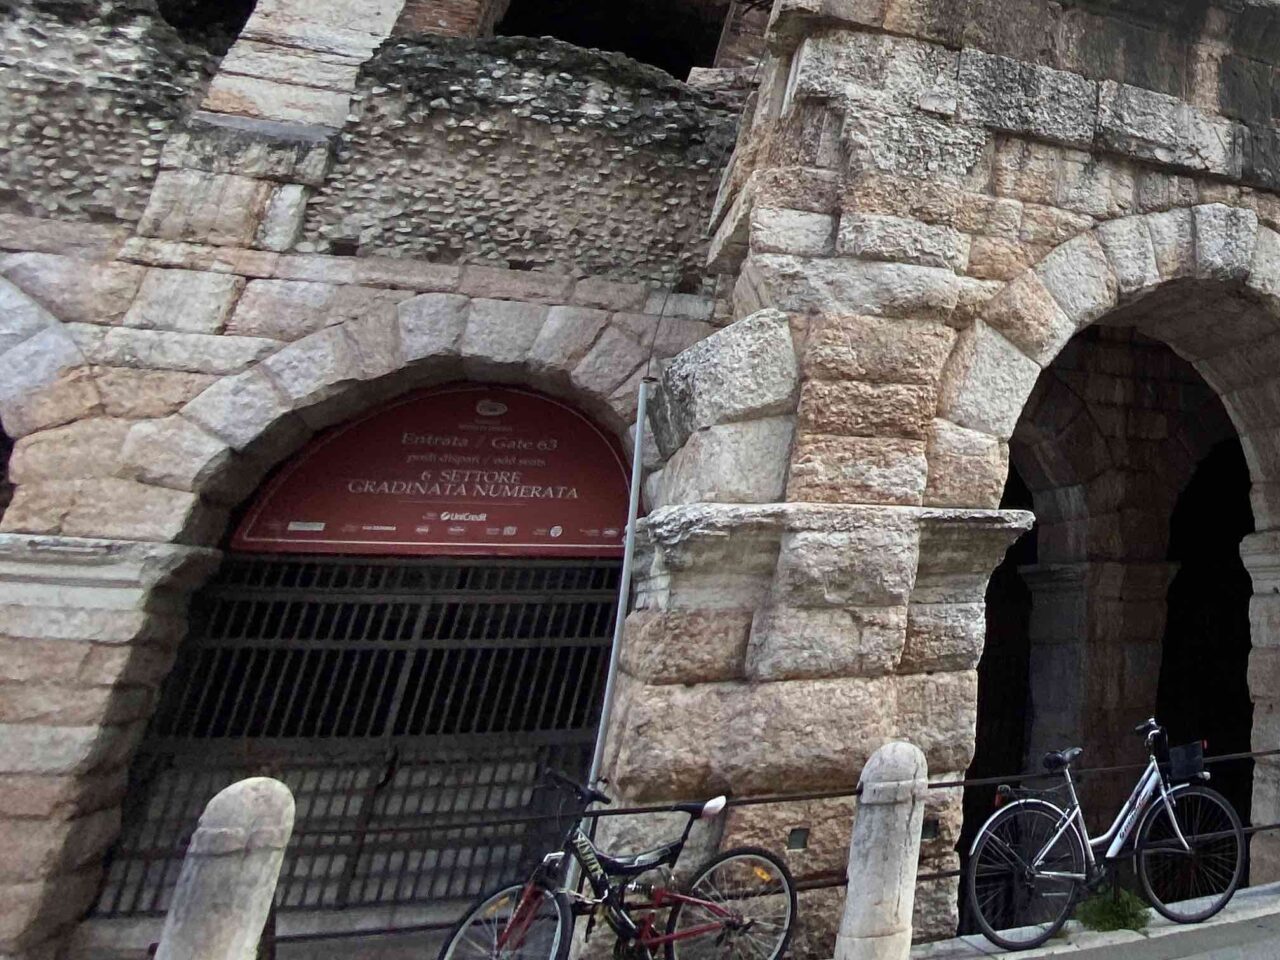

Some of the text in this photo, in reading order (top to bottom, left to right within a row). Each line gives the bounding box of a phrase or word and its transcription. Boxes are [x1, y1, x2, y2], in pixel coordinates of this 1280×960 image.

[401, 432, 468, 447] Entrata
[491, 437, 533, 450] Gate
[440, 470, 522, 484] SETTORE
[348, 480, 579, 498] GRADINATA NUMERATA
[450, 512, 487, 521] UniCredit
